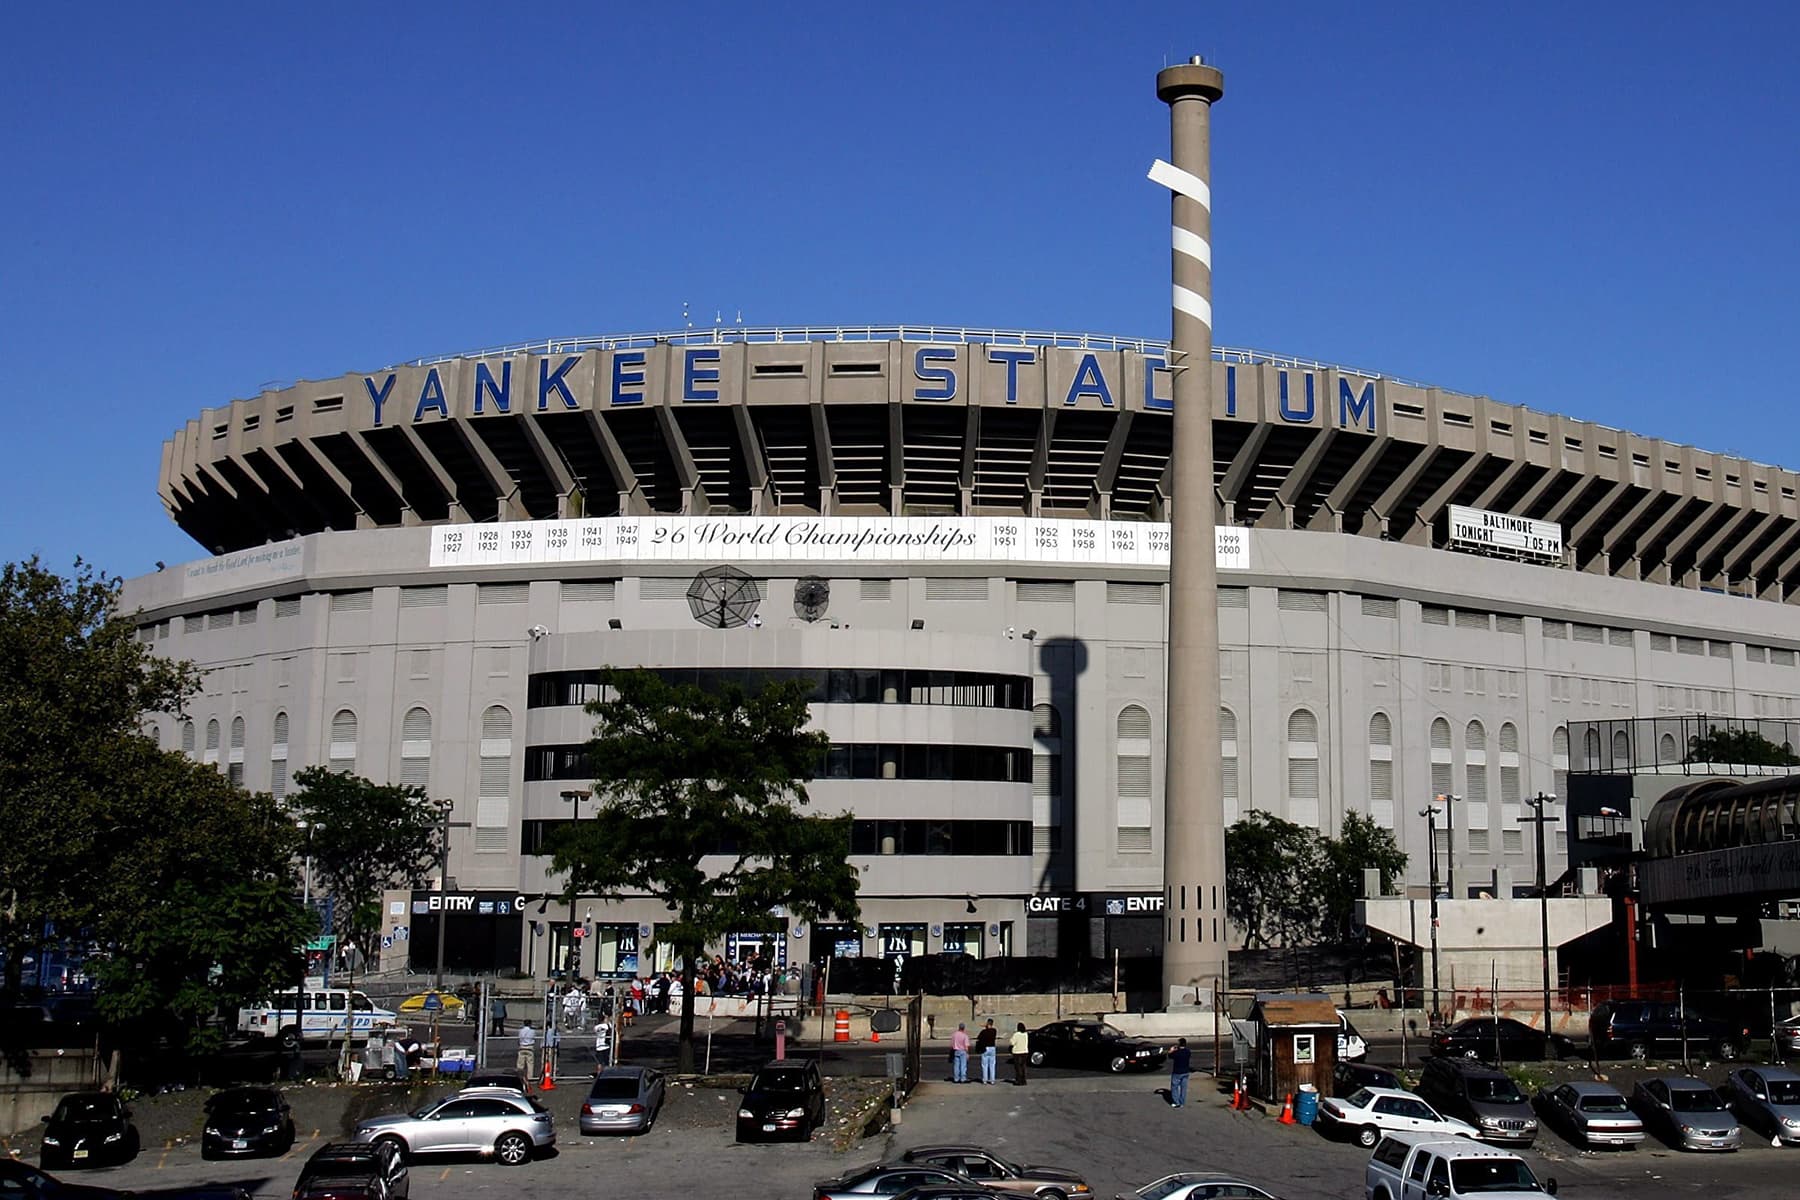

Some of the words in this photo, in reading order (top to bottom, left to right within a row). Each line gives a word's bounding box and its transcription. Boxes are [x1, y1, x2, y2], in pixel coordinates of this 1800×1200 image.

[363, 348, 721, 426] YANKEE
[912, 346, 1376, 431] STADIUM
[1483, 514, 1533, 534] BALTIMORE
[443, 533, 463, 542] 1923
[479, 531, 498, 541] 1928
[511, 530, 532, 539] 1936
[547, 528, 568, 537] 1938
[582, 527, 602, 536] 1941
[616, 525, 638, 534] 1947
[651, 526, 685, 544] 26
[694, 522, 781, 545] World
[785, 521, 977, 552] Championships
[994, 526, 1017, 535] 1950
[1035, 527, 1058, 536] 1952
[1072, 528, 1095, 538] 1956
[1111, 529, 1133, 539] 1961
[1148, 531, 1169, 540] 1977
[1218, 535, 1240, 544] 1999
[1456, 524, 1494, 542] TONIGHT
[1548, 540, 1559, 553] PM
[443, 543, 462, 552] 1927
[477, 542, 498, 551] 1932
[510, 540, 531, 549] 1937
[546, 539, 567, 548] 1939
[581, 537, 602, 546] 1943
[616, 536, 637, 545] 1949
[994, 537, 1016, 546] 1951
[1035, 538, 1058, 548] 1953
[1072, 539, 1095, 549] 1958
[1111, 540, 1135, 550] 1962
[1148, 541, 1170, 551] 1978
[1218, 545, 1240, 554] 2000
[1030, 897, 1071, 911] GATE
[1076, 898, 1086, 910] 4
[1127, 897, 1164, 910] ENTR
